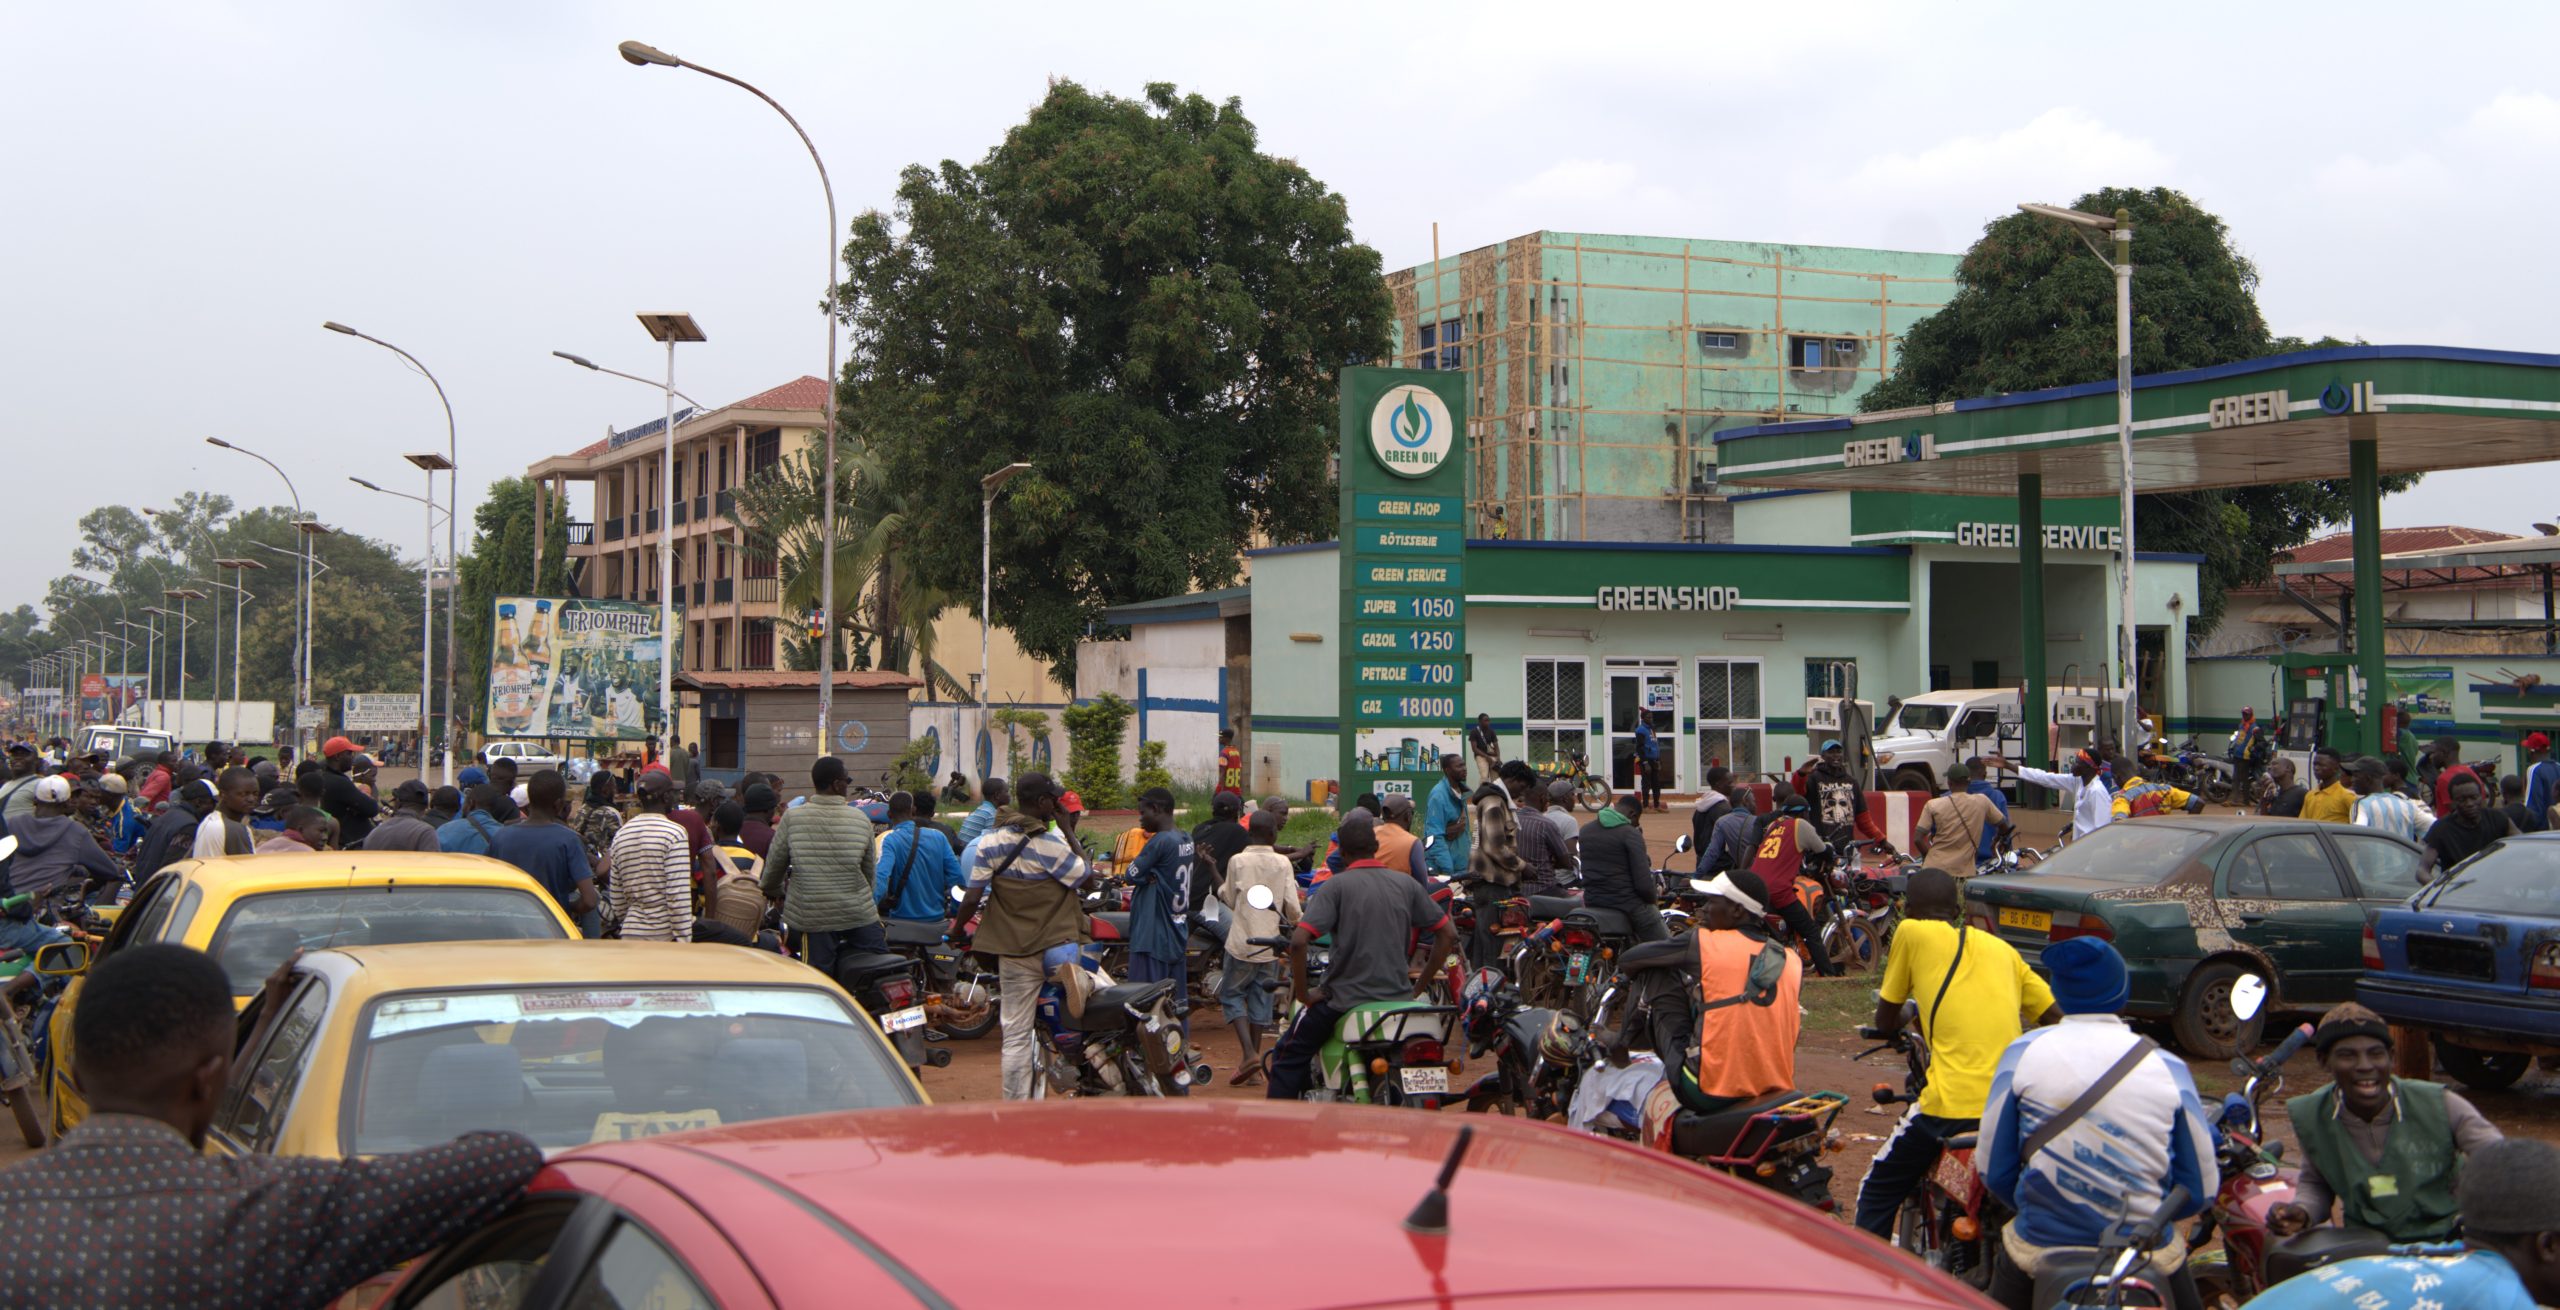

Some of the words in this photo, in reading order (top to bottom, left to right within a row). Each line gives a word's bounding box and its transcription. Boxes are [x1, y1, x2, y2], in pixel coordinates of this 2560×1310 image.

[2209, 389, 2289, 429] GREEN
[1385, 450, 1418, 463] GREEN
[1422, 452, 1439, 464] OIL
[1843, 436, 1902, 468] GREEN
[1378, 501, 1411, 515] GREEN
[1413, 502, 1441, 516] SHOP
[1371, 567, 1404, 582] GREEN
[1407, 568, 1447, 582] SERVICE
[1363, 600, 1397, 614] SUPER
[1412, 598, 1454, 617] 1050
[1598, 586, 1672, 611] GREEN
[1677, 586, 1740, 611] SHOP
[566, 610, 652, 637] TRIOMPHE
[1362, 633, 1397, 647] GAZOIL
[1410, 631, 1453, 650] 1250
[1362, 667, 1407, 681] PETROLE
[1421, 664, 1453, 683] 700
[493, 683, 532, 698] TRIOMPHE
[1655, 685, 1672, 693] Gaz
[1362, 700, 1382, 714] GAZ
[1400, 697, 1454, 717] 18000
[1384, 782, 1410, 793] Gaz
[1759, 836, 1782, 859] 23
